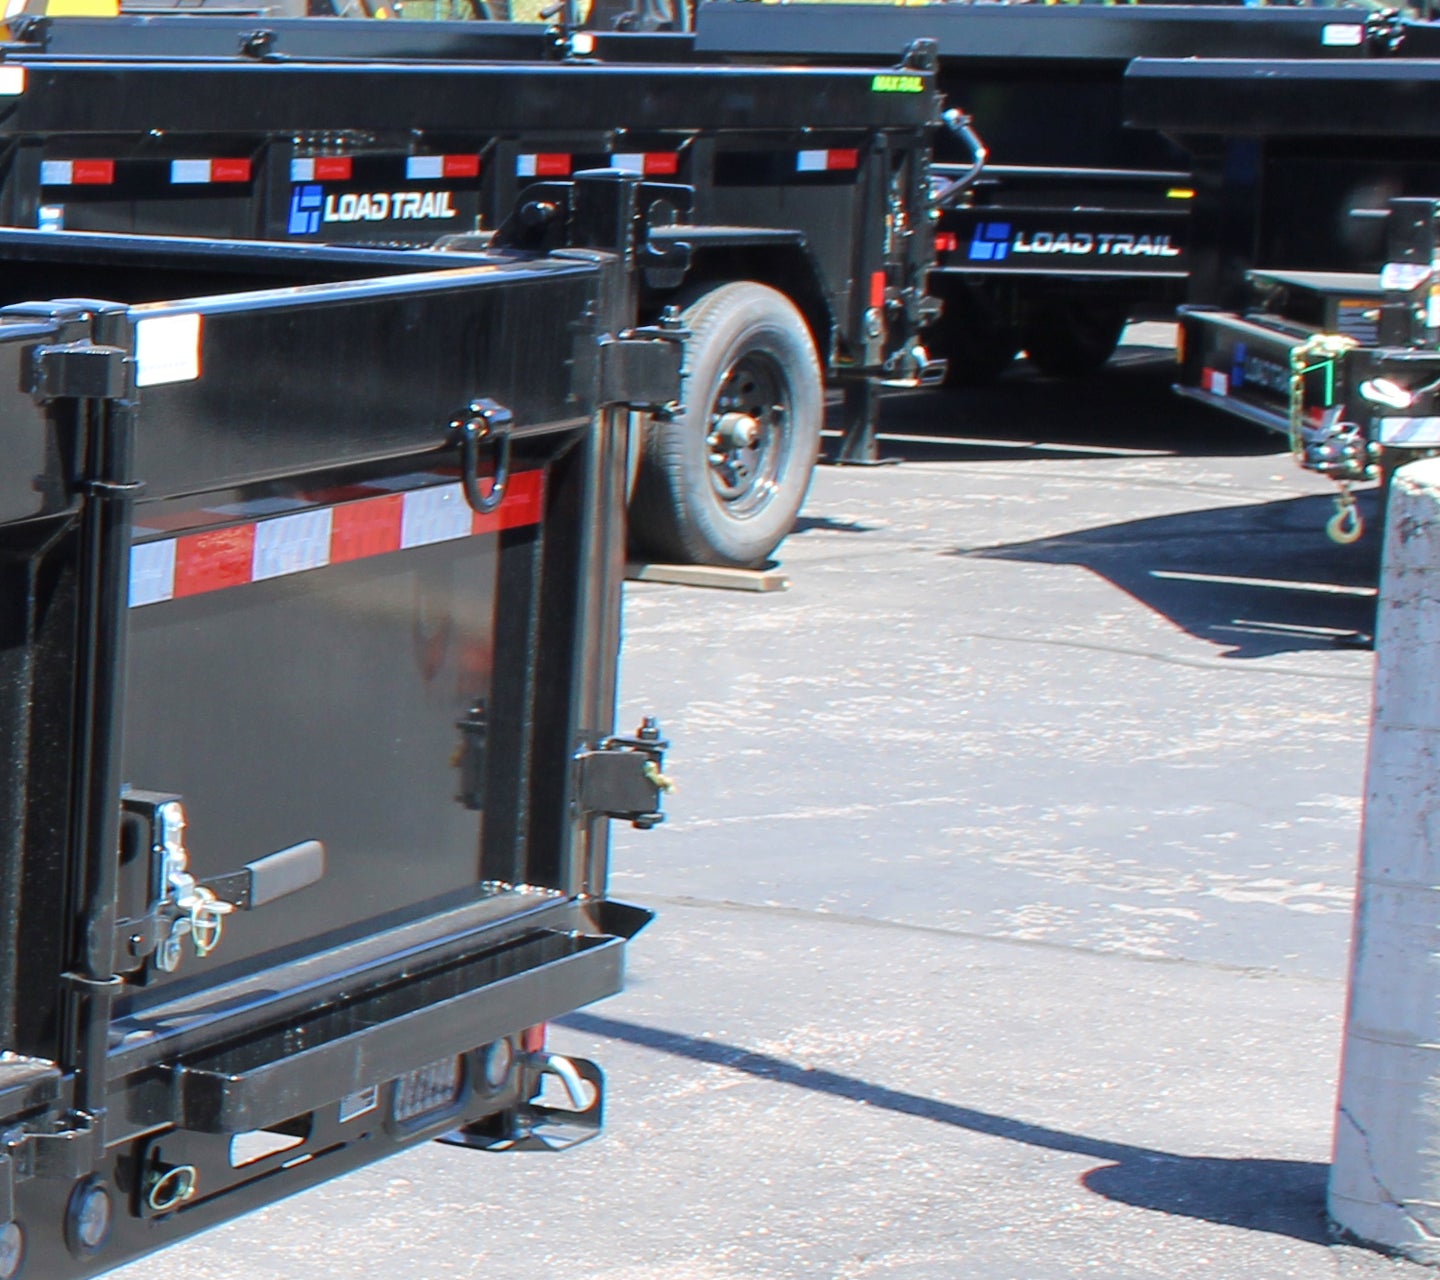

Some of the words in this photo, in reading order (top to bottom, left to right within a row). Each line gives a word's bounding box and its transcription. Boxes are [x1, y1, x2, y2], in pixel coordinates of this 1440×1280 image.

[323, 193, 391, 223] LOAD
[391, 190, 458, 220] TRAIL
[1012, 231, 1095, 254] LOAD
[1096, 233, 1182, 257] TRAIL
